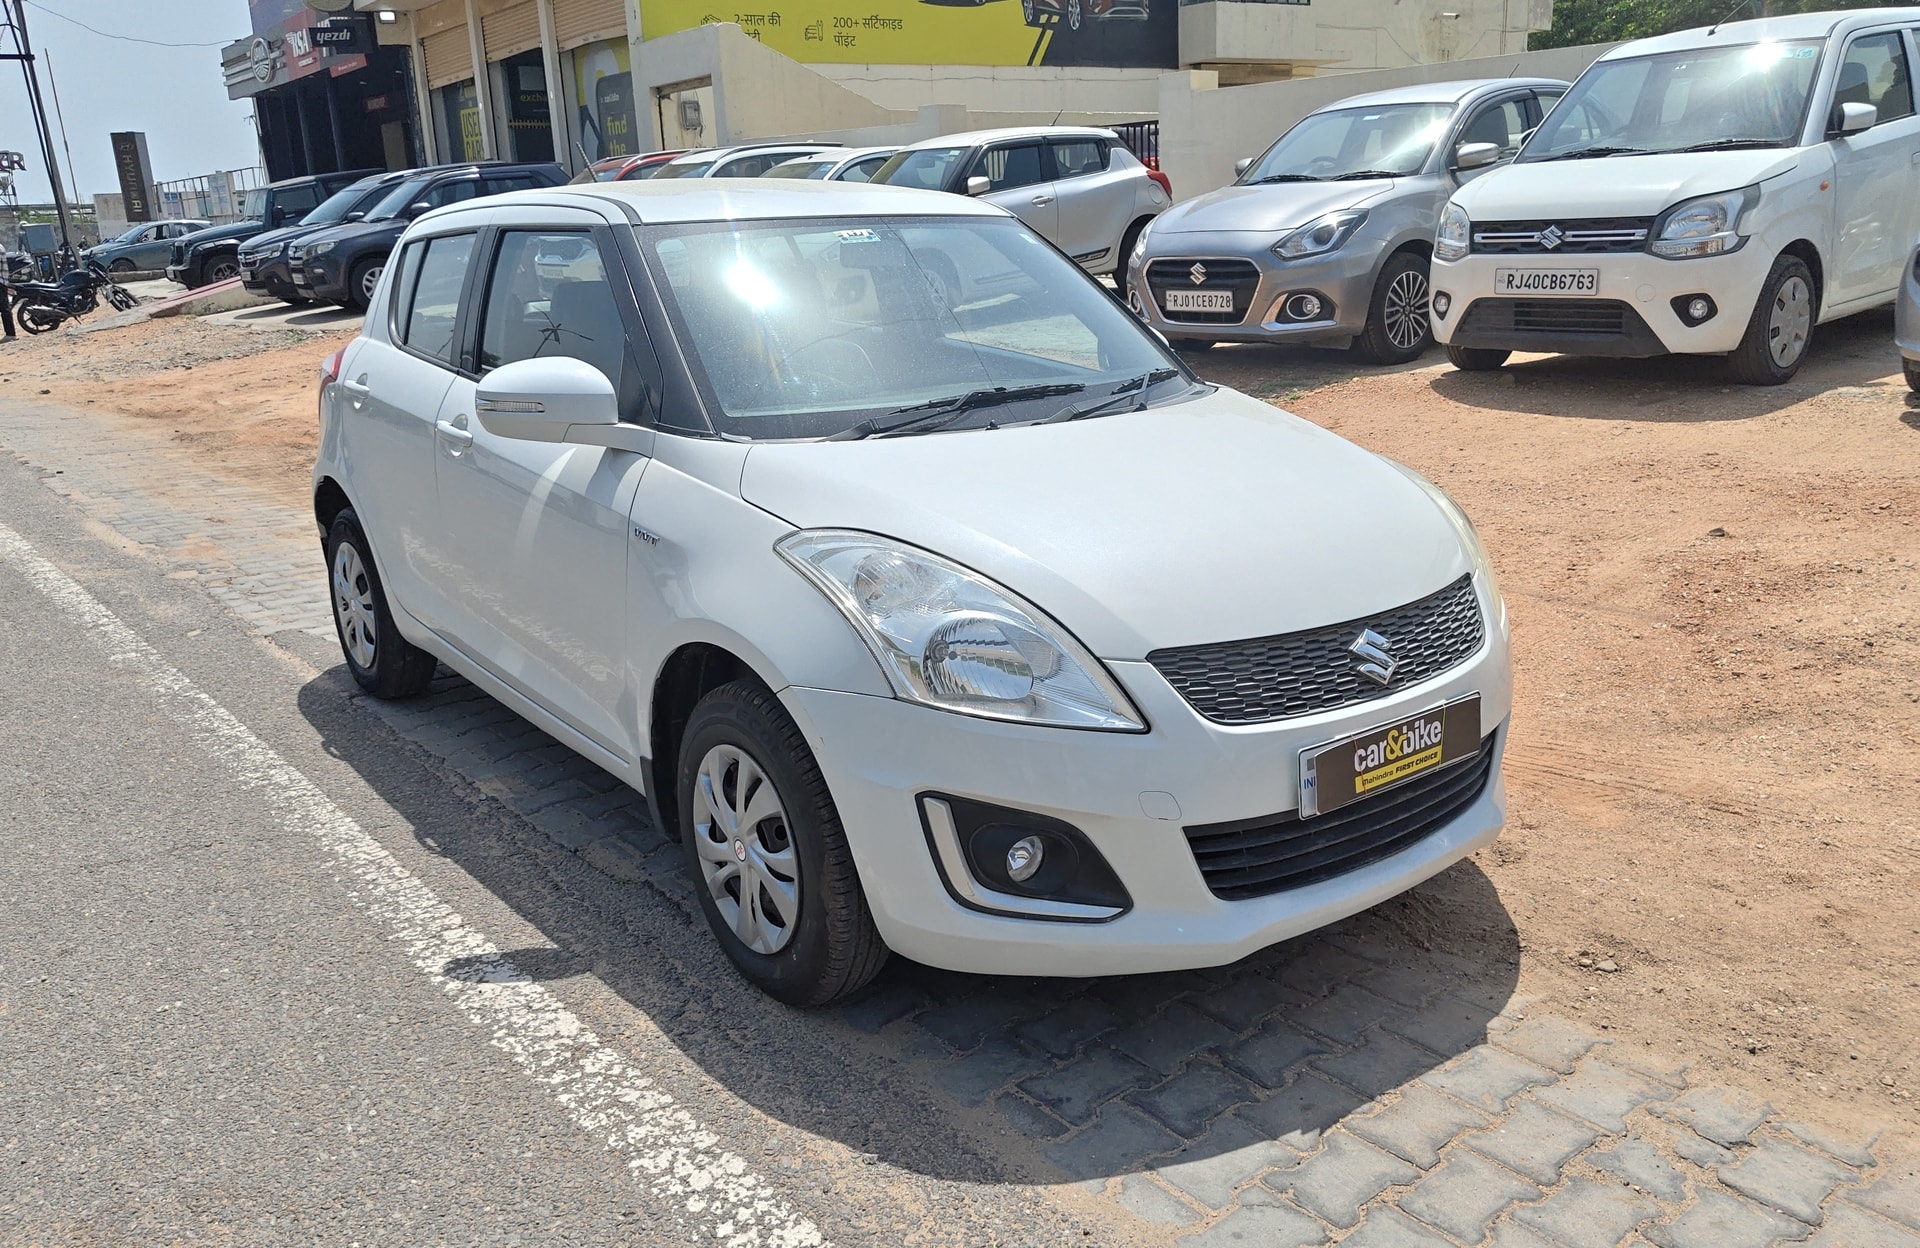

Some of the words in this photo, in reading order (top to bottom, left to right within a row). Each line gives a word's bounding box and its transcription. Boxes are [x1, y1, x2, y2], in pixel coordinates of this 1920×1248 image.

[768, 11, 781, 26] की
[833, 16, 860, 29] 200+
[862, 14, 903, 31] सर्टिफाइड
[316, 28, 351, 44] yezdi
[833, 32, 856, 48] पॉइंट
[607, 113, 627, 136] find
[610, 139, 626, 157] the
[1506, 273, 1595, 290] RJ40CB6763
[1172, 294, 1231, 308] RJ01CE8728
[1354, 719, 1442, 772] car&bike
[1362, 770, 1394, 787] Mahindra
[1395, 760, 1415, 774] FIRST
[1415, 751, 1438, 766] CHOICE
